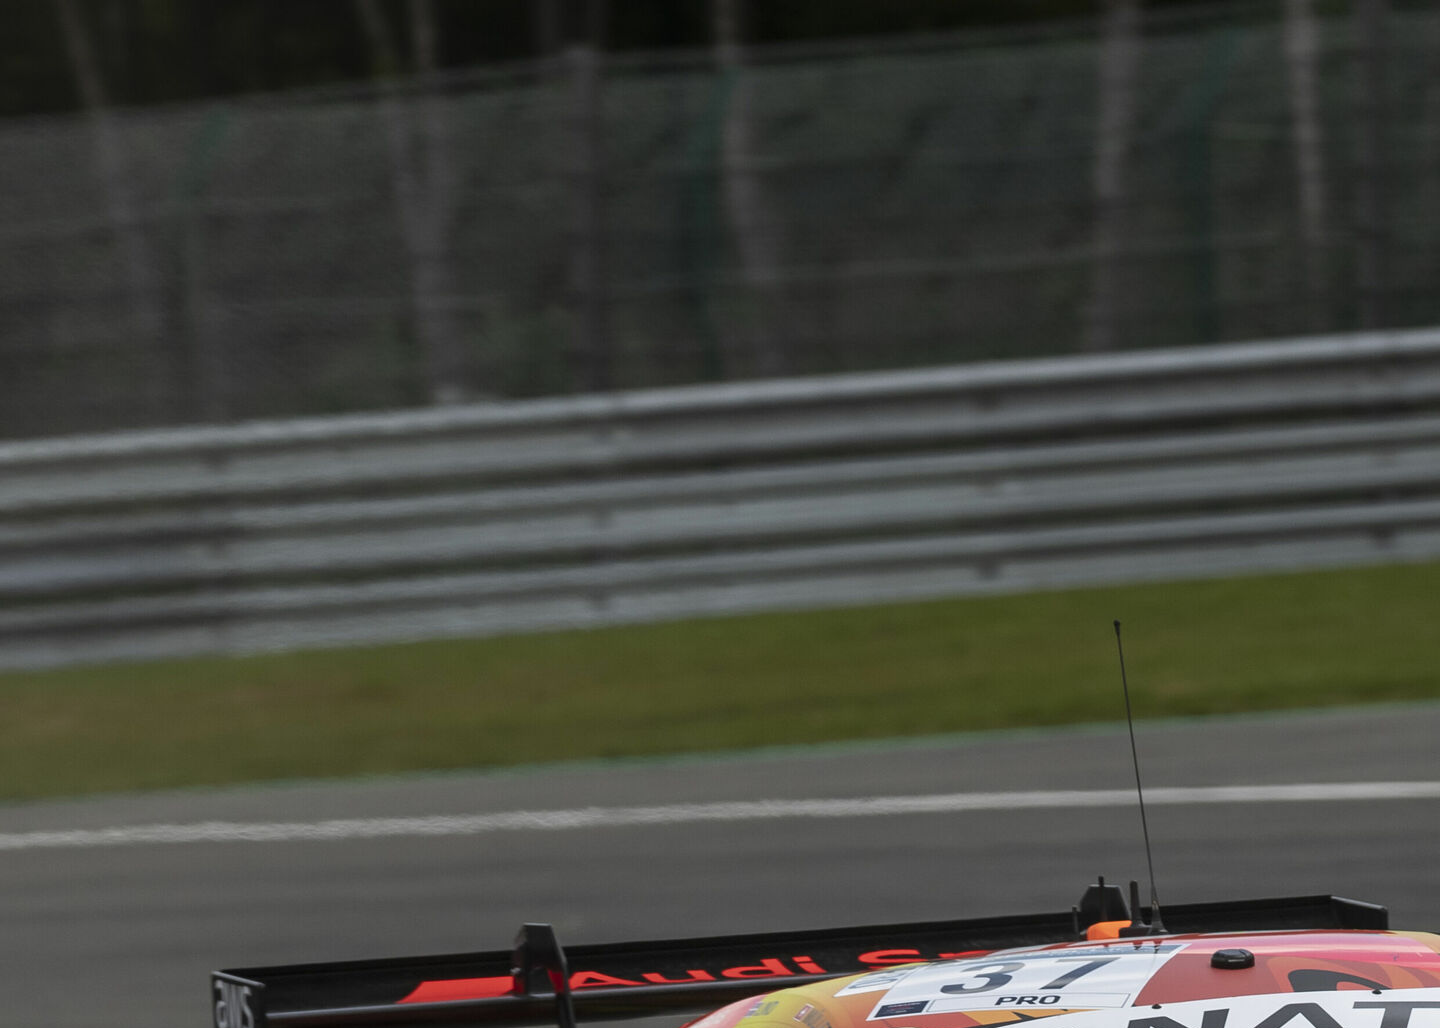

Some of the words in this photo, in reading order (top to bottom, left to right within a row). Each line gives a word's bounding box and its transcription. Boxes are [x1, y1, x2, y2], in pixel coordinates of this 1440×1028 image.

[570, 955, 827, 992] Audi
[941, 957, 1123, 995] 37
[995, 995, 1061, 1007] PRO
